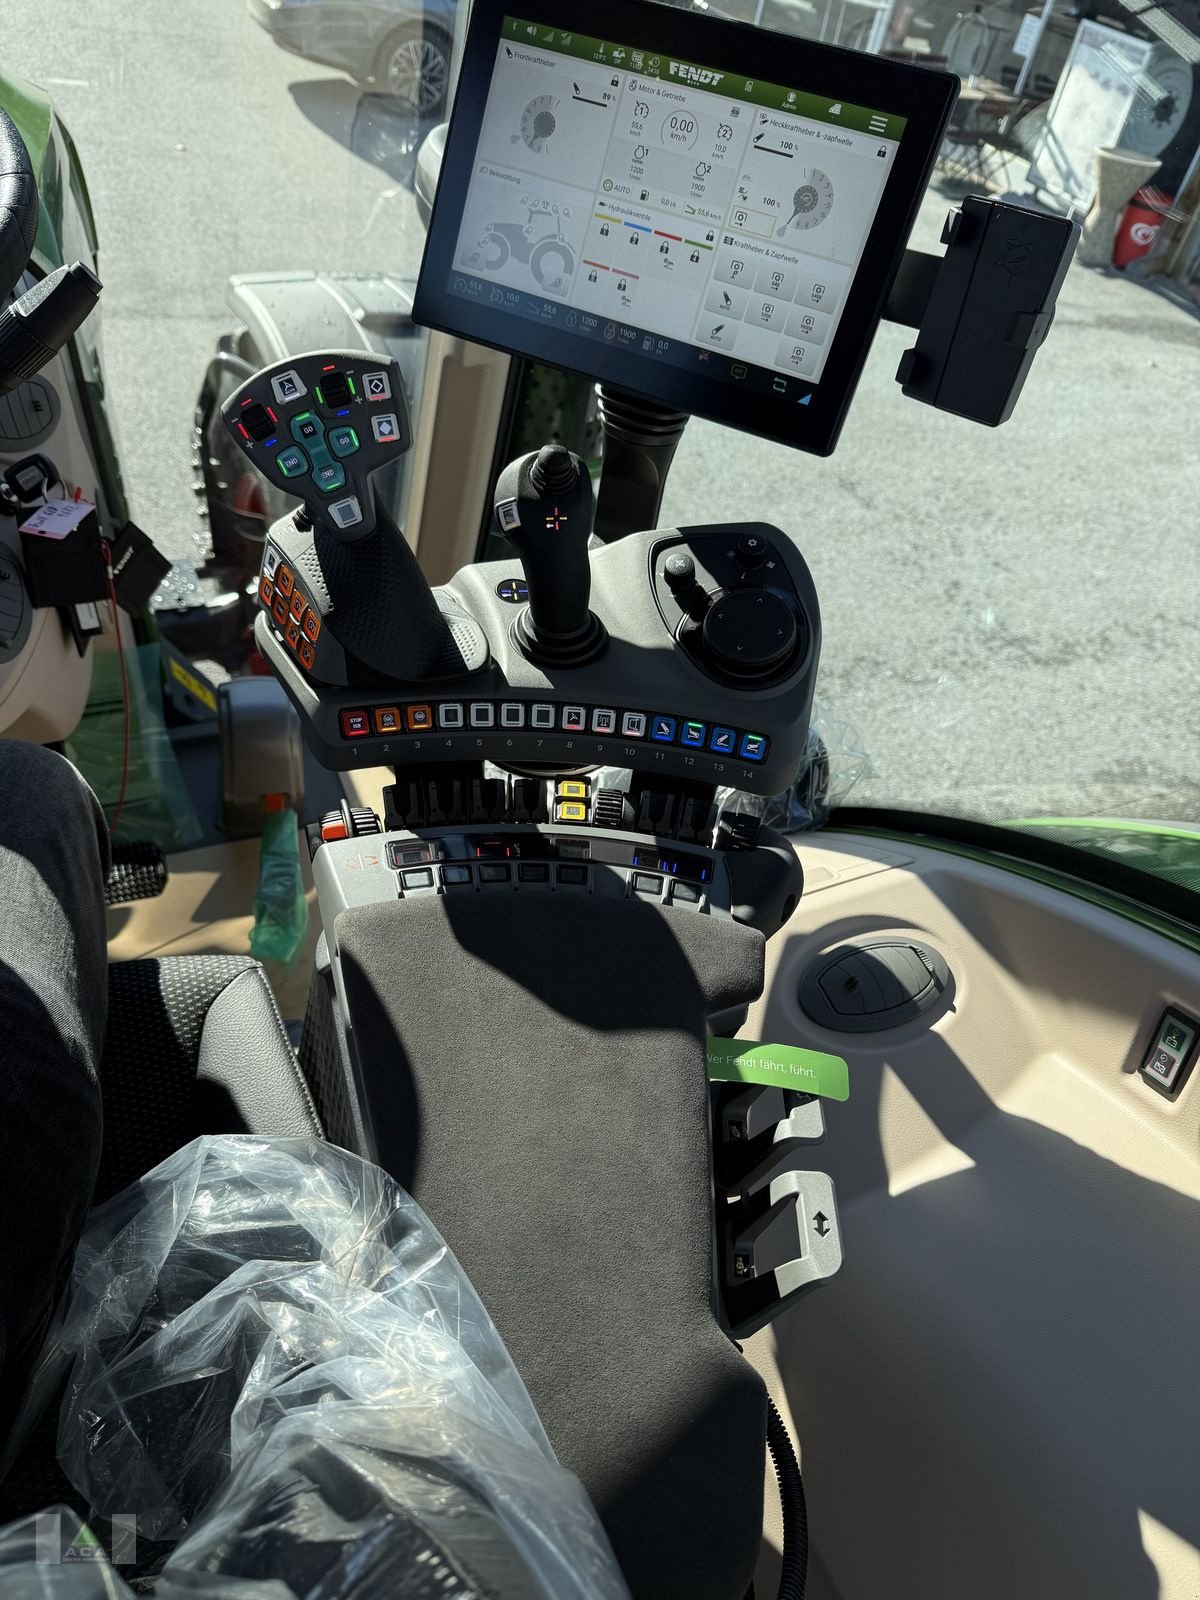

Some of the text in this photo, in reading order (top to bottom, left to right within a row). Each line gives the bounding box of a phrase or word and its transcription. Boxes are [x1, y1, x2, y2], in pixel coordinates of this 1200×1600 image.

[514, 52, 556, 68] Frontkraftheber
[669, 61, 724, 86] FENDT
[602, 92, 611, 101] 89
[638, 84, 687, 103] Motor & Getriebe
[670, 117, 694, 133] 0,00
[670, 132, 687, 142] km/h
[770, 118, 853, 148] Heckkraftheber & -zapfwelle
[780, 140, 793, 150] 100
[488, 168, 521, 184] Beleuchtung
[630, 165, 644, 175] 1200
[614, 184, 631, 195] AUTO
[691, 182, 706, 192] 1900
[762, 196, 776, 207] 100
[608, 203, 652, 221] Hydraulikventile
[733, 240, 799, 265] Kraftheber & Zapfwelle
[581, 315, 598, 329] 1200
[619, 327, 636, 341] 1900
[303, 425, 314, 435] GO
[339, 436, 350, 445] GO
[285, 457, 298, 468] END
[321, 469, 335, 479] END
[352, 748, 358, 756] 1
[383, 744, 390, 752] 2
[415, 741, 421, 749] 3
[537, 739, 544, 747] 7
[567, 741, 573, 749] 8
[597, 744, 603, 752] 9
[625, 748, 635, 757] 10
[655, 752, 665, 761] 11
[683, 757, 695, 766] 12
[713, 762, 725, 772] 13
[742, 770, 753, 779] 14
[727, 1055, 756, 1068] Fendt
[760, 1058, 787, 1074] fährt,
[790, 1063, 817, 1079] führt.
